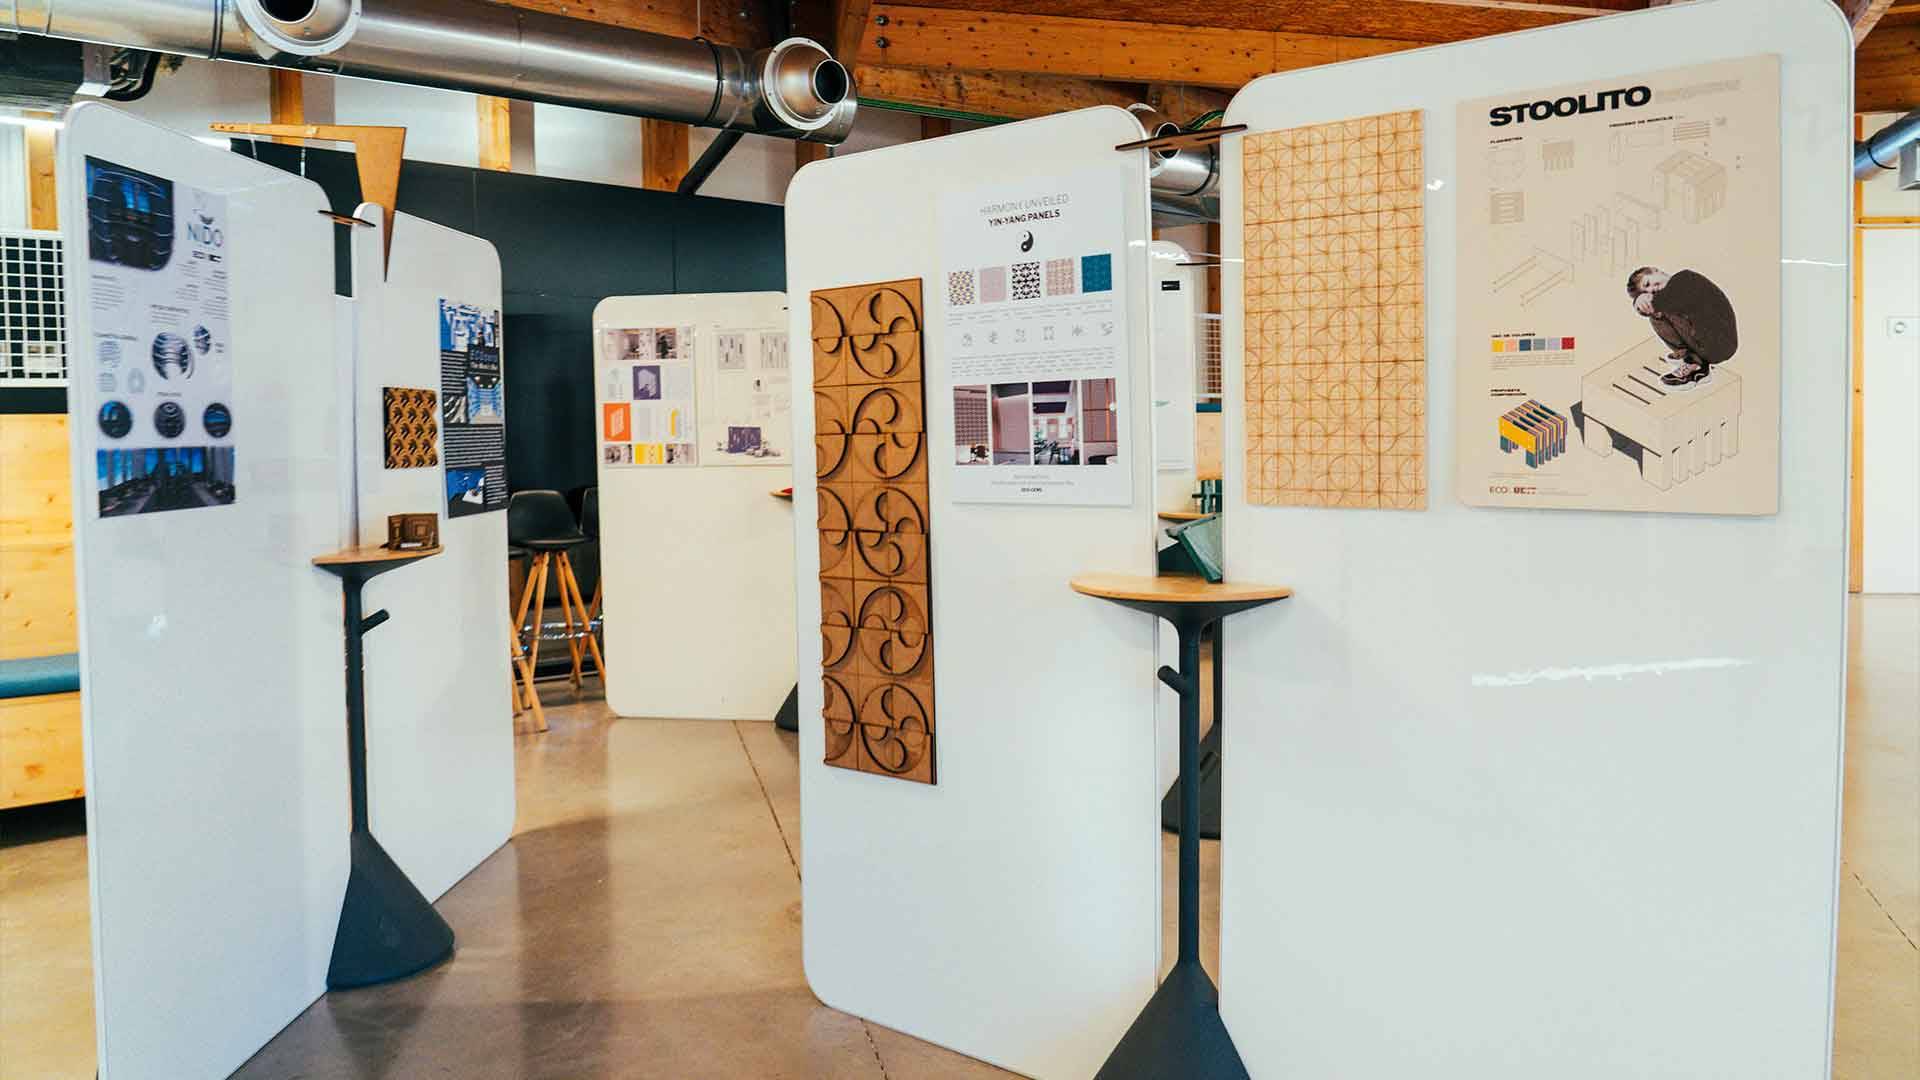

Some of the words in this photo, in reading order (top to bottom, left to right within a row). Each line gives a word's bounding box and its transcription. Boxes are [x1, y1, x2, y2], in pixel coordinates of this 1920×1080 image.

[1489, 85, 1652, 127] STOOLITO
[980, 202, 1023, 214] HARMONY
[1024, 193, 1069, 209] UNVEILED
[988, 214, 1026, 226] YIN-YANG
[1028, 209, 1060, 221] PANELS
